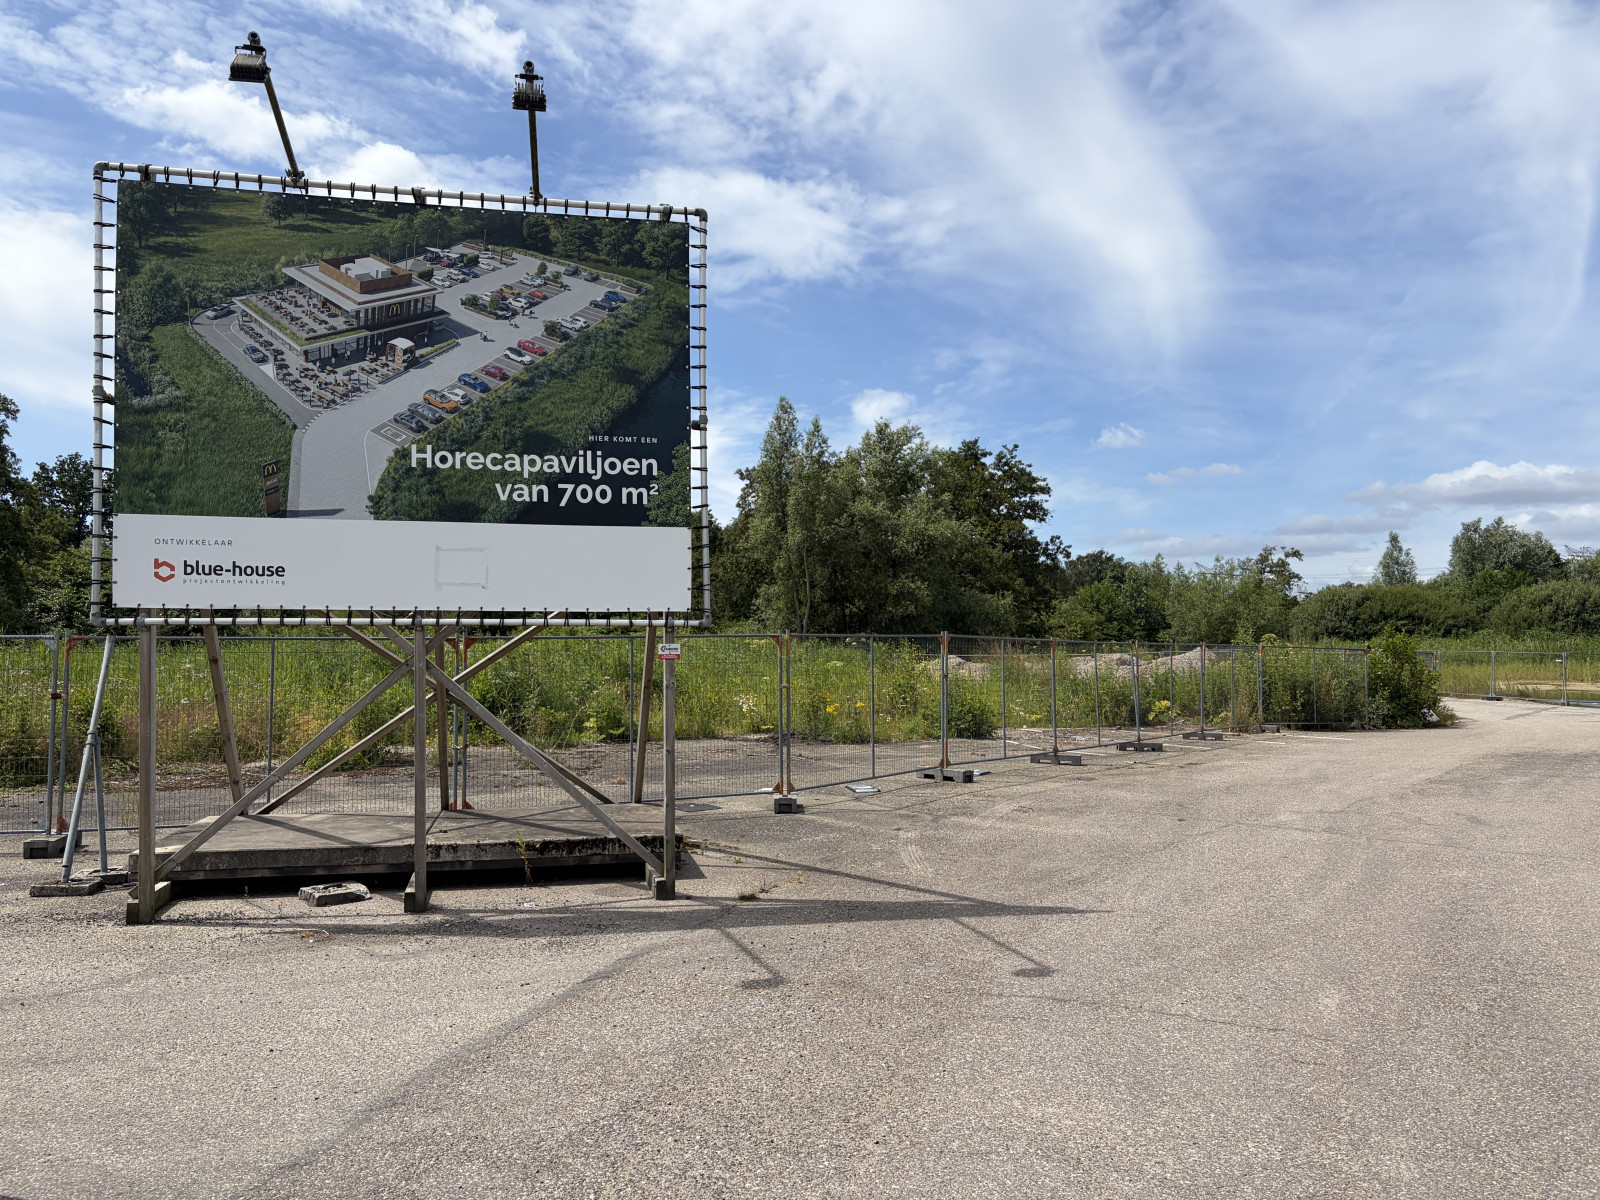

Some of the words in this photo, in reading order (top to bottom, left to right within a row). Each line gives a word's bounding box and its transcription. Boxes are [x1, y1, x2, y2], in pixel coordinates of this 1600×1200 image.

[411, 444, 658, 480] Horecapaviljoen
[495, 483, 549, 502] van
[558, 484, 612, 507] 700
[622, 484, 659, 505] m²
[154, 538, 233, 547] ONTWIKKELAAR
[183, 560, 286, 578] blue-house
[182, 578, 286, 586] projectontwikkeling
